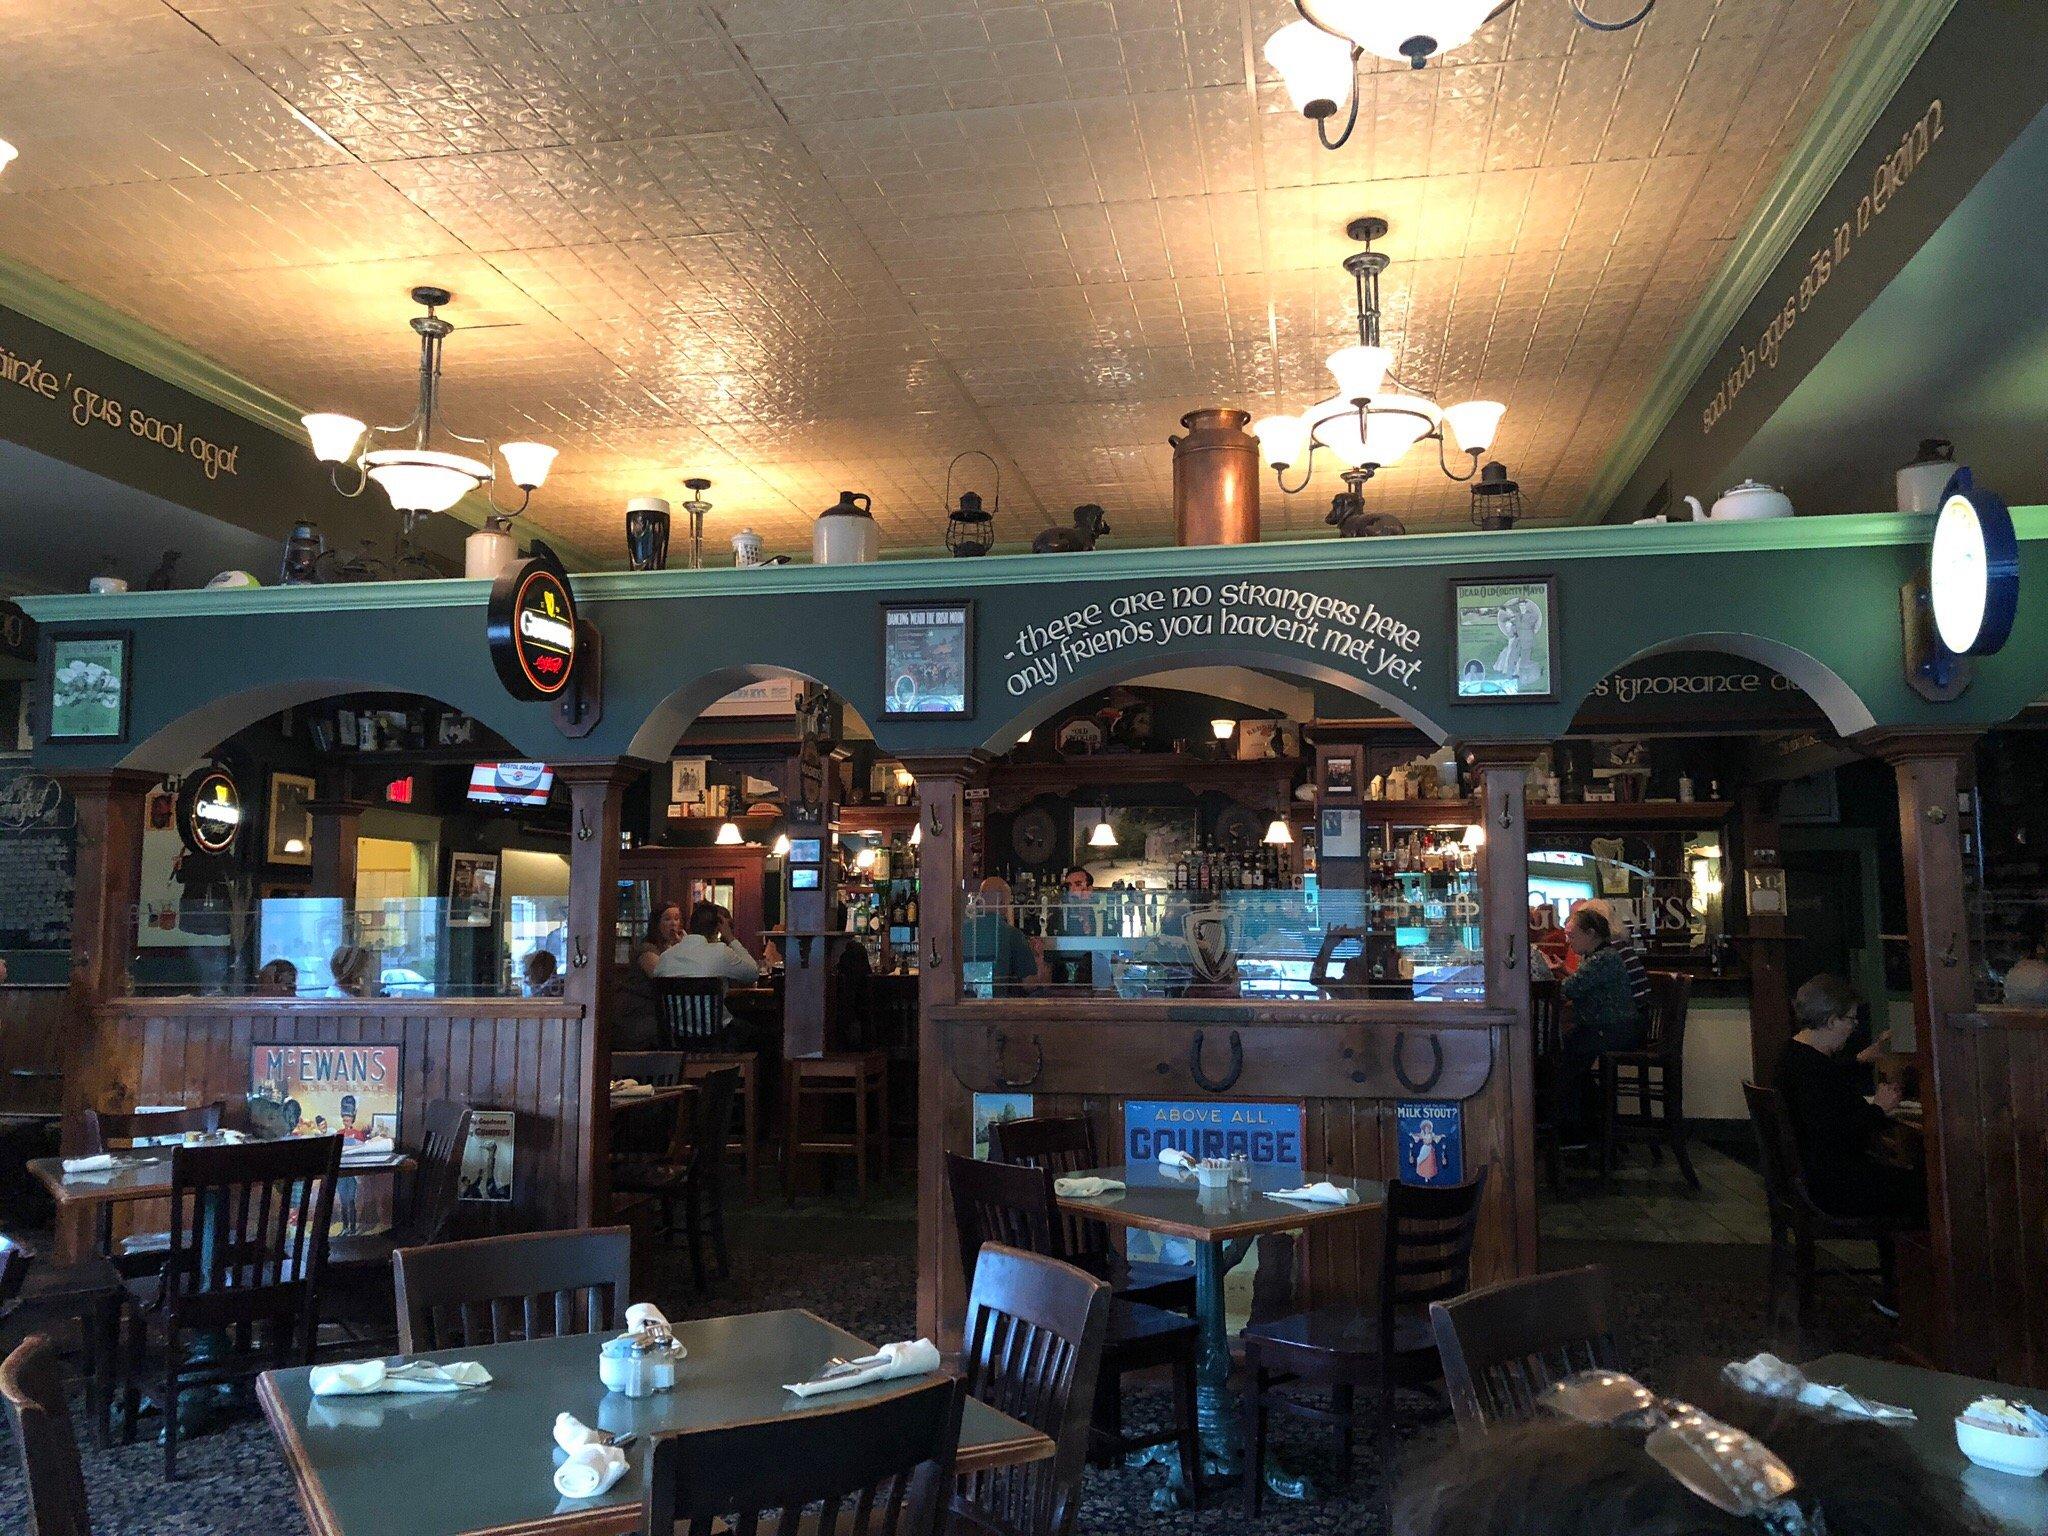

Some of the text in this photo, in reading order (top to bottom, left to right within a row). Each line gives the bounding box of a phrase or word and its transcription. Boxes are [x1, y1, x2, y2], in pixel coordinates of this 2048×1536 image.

[129, 409, 184, 453] saol
[189, 436, 239, 480] agat
[1015, 580, 1422, 657] there are no strangers here
[1006, 652, 1059, 697] only
[1060, 618, 1155, 674] friends
[1158, 612, 1212, 645] you
[1321, 628, 1375, 665] met
[1615, 674, 1761, 703] ignorance
[1154, 1107, 1223, 1123] ABOVE
[1397, 1107, 1458, 1119] MILK STOUT?
[1130, 1126, 1297, 1164] COURAGE
